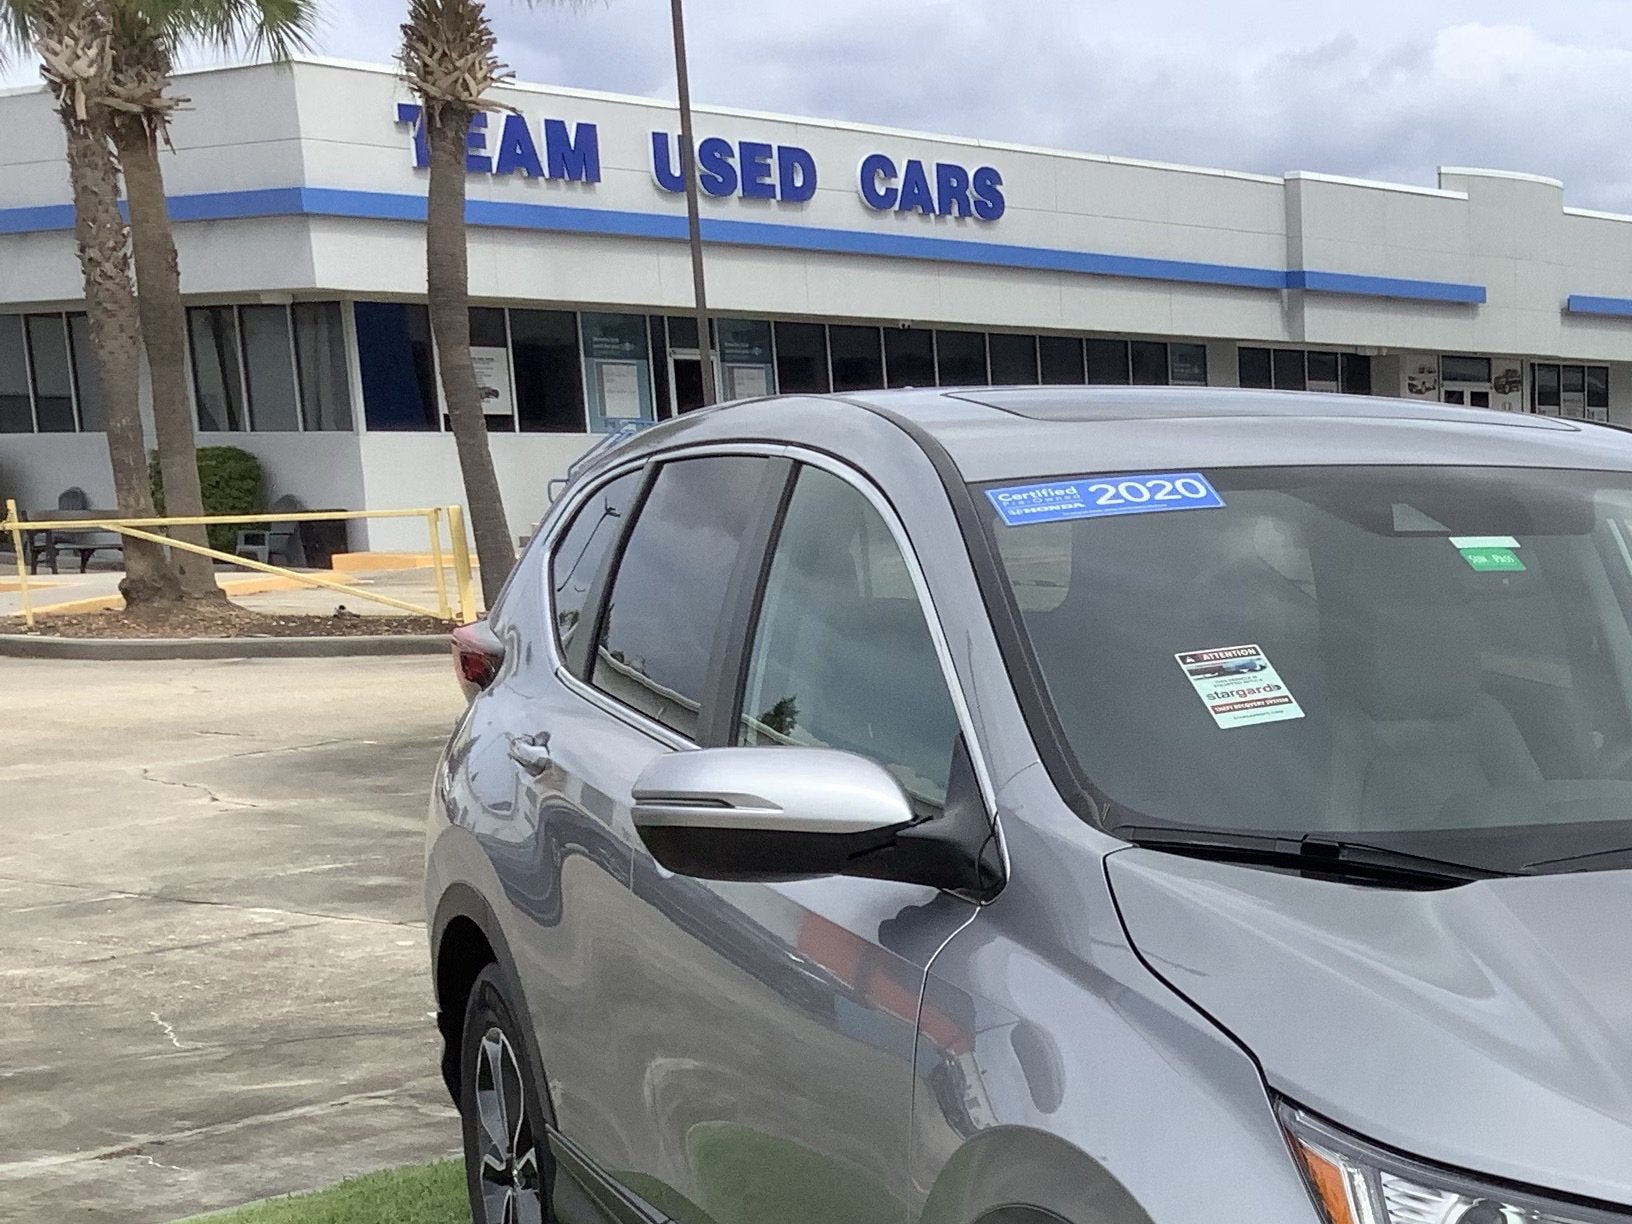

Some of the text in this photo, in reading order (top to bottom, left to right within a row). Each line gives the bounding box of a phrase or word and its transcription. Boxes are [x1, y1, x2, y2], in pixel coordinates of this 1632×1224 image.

[651, 131, 818, 203] USED
[859, 153, 1006, 222] CARS
[997, 486, 1077, 502] Certified
[1087, 478, 1208, 505] 2020
[1022, 503, 1086, 514] HONDA
[1202, 647, 1257, 661] ATTENTION
